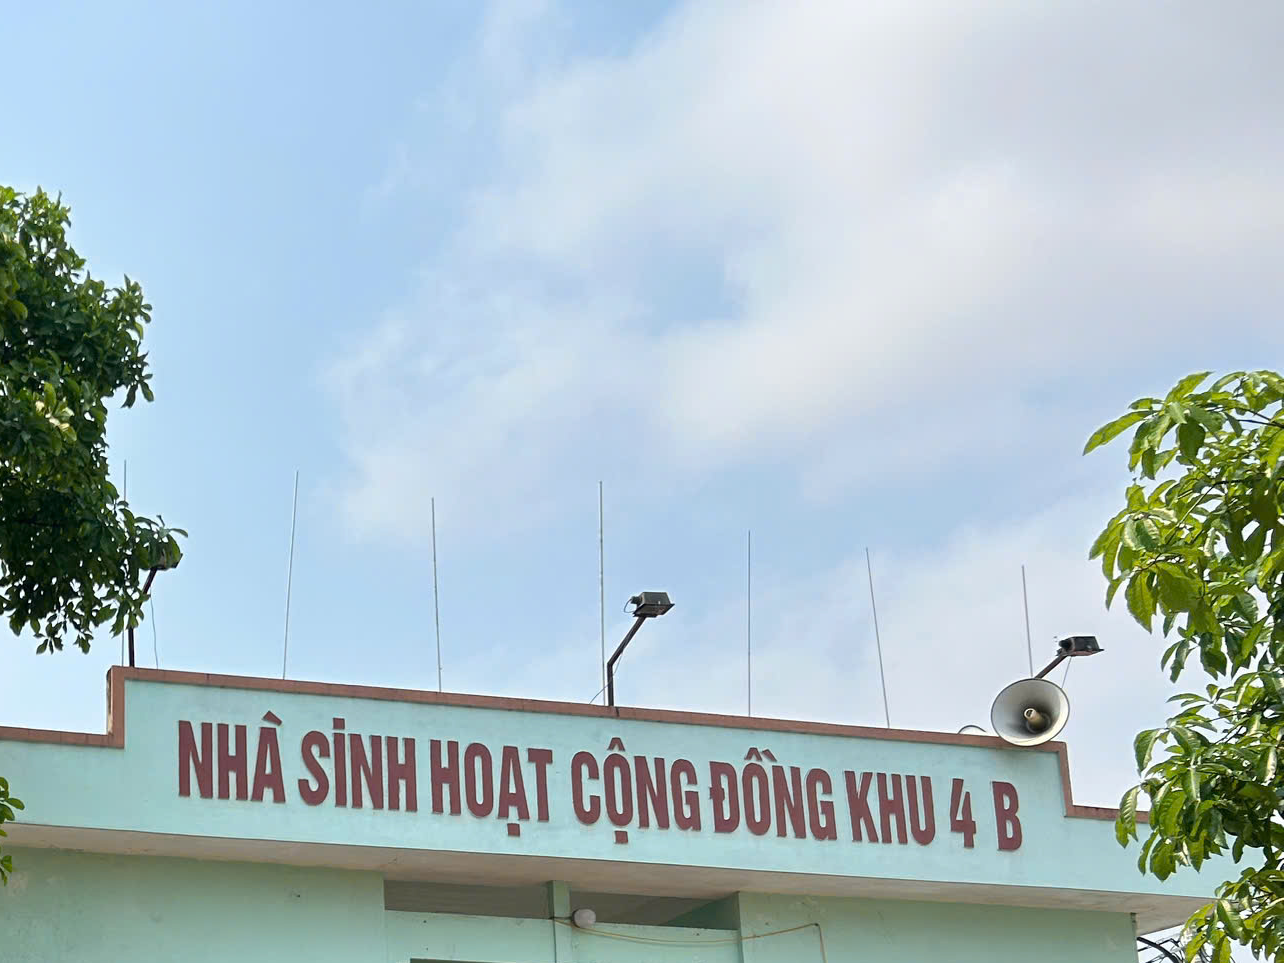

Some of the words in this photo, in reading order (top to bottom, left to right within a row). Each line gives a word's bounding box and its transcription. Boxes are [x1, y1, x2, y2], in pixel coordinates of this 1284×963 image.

[178, 711, 286, 803] NHÀ
[430, 739, 553, 837] HOẠT
[571, 737, 702, 844] CỘNG
[709, 747, 837, 841] ĐỒNG
[844, 770, 936, 846] KHU
[950, 778, 977, 848] 4
[992, 781, 1023, 851] B
